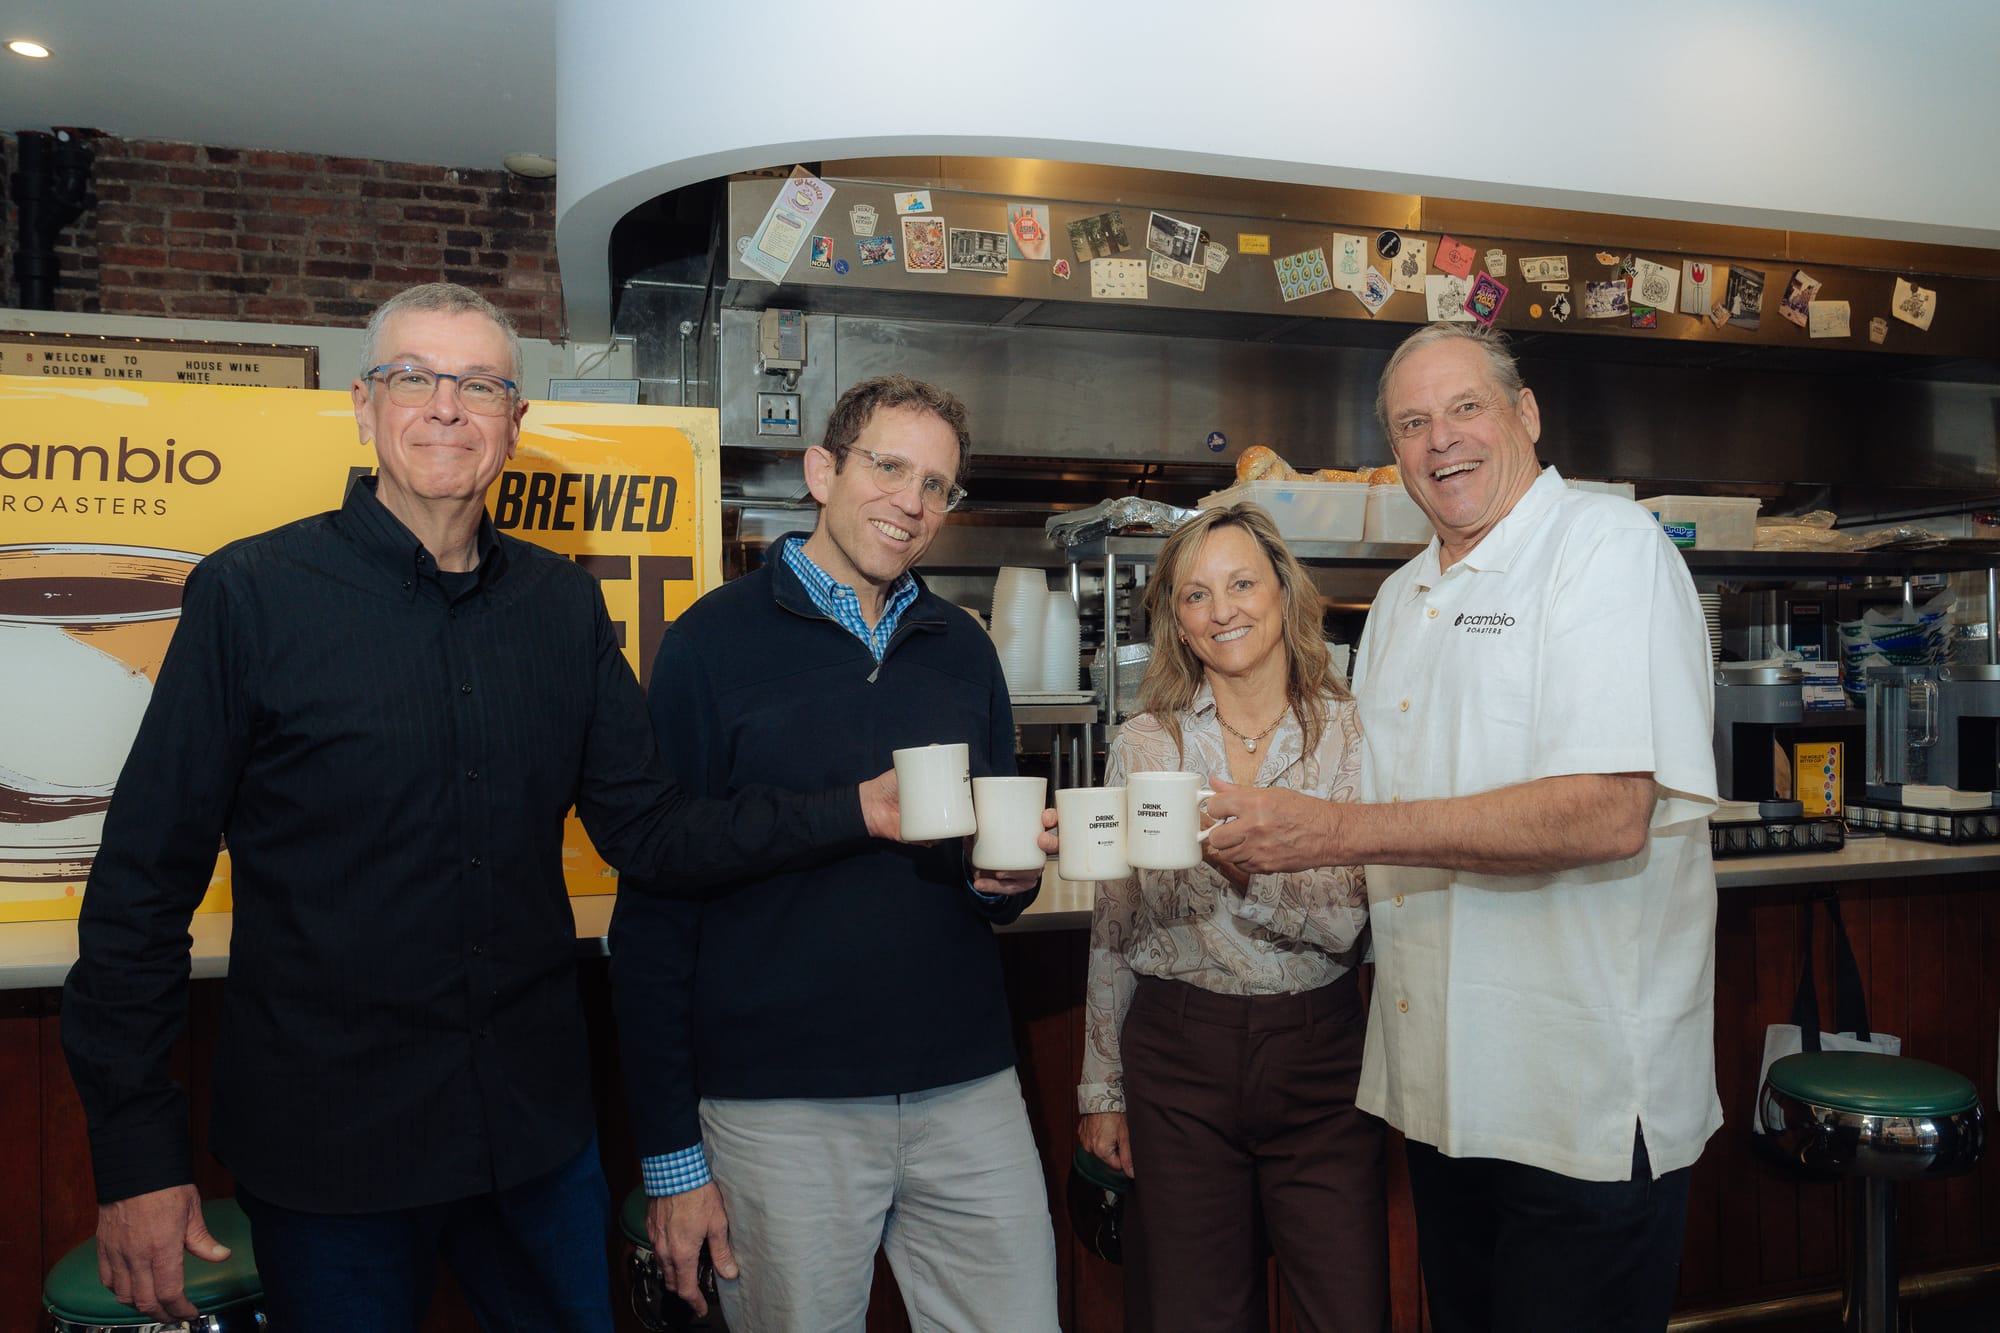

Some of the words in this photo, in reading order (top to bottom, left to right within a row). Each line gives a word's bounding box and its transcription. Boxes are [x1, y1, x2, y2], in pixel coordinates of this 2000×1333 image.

[26, 353, 33, 362] 8
[44, 352, 106, 363] WELCOME
[124, 356, 138, 365] TO
[43, 366, 92, 376] GOLDEN
[105, 368, 143, 378] DINER
[186, 361, 223, 371] HOUSE
[229, 363, 260, 372] WINE
[177, 372, 210, 381] WHITE
[2, 495, 167, 516] ROASTERS
[493, 472, 678, 533] BREWED
[1464, 613, 1515, 626] cambio
